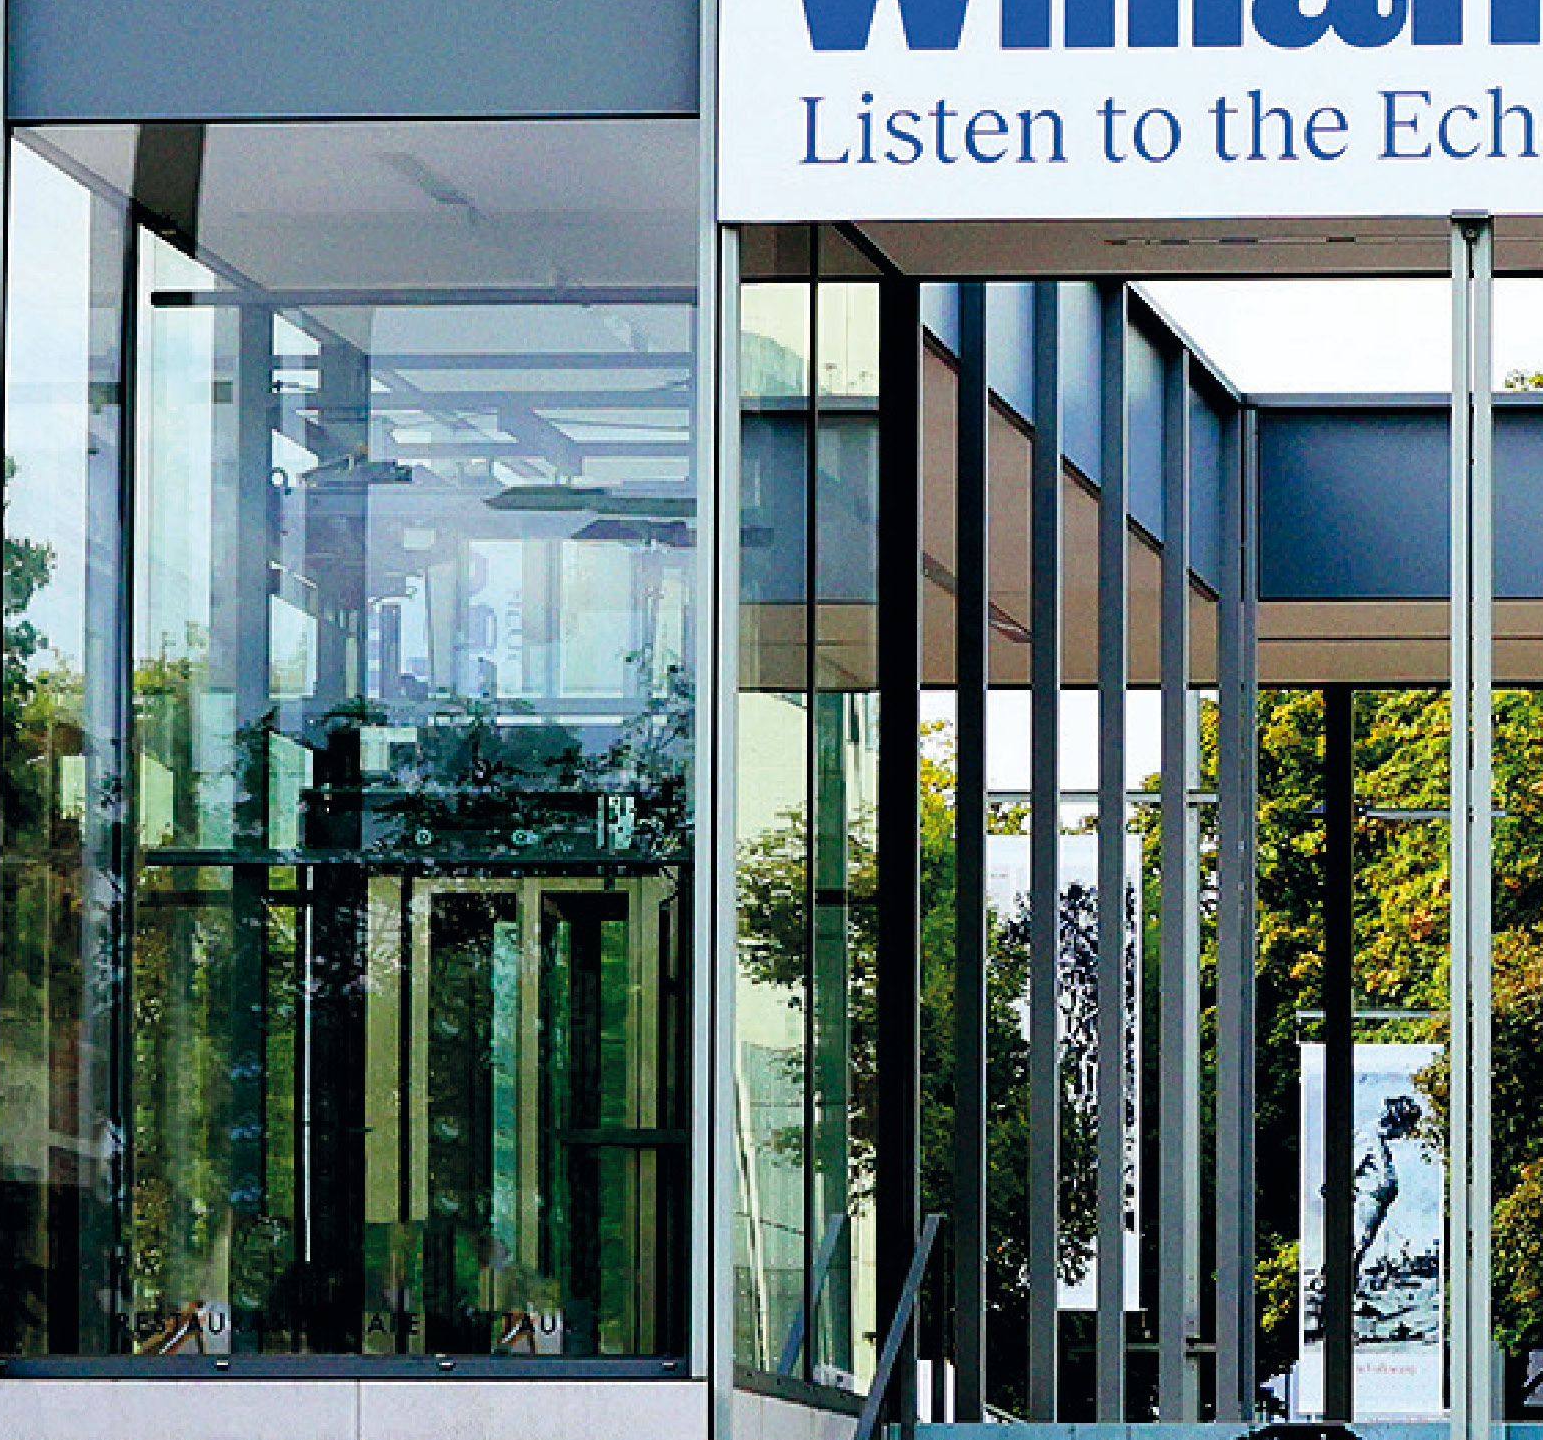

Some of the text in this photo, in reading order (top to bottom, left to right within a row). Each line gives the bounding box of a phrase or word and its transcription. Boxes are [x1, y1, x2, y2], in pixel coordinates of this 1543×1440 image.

[799, 90, 1066, 165] Listen
[1098, 99, 1184, 163] to
[1211, 90, 1350, 162] the
